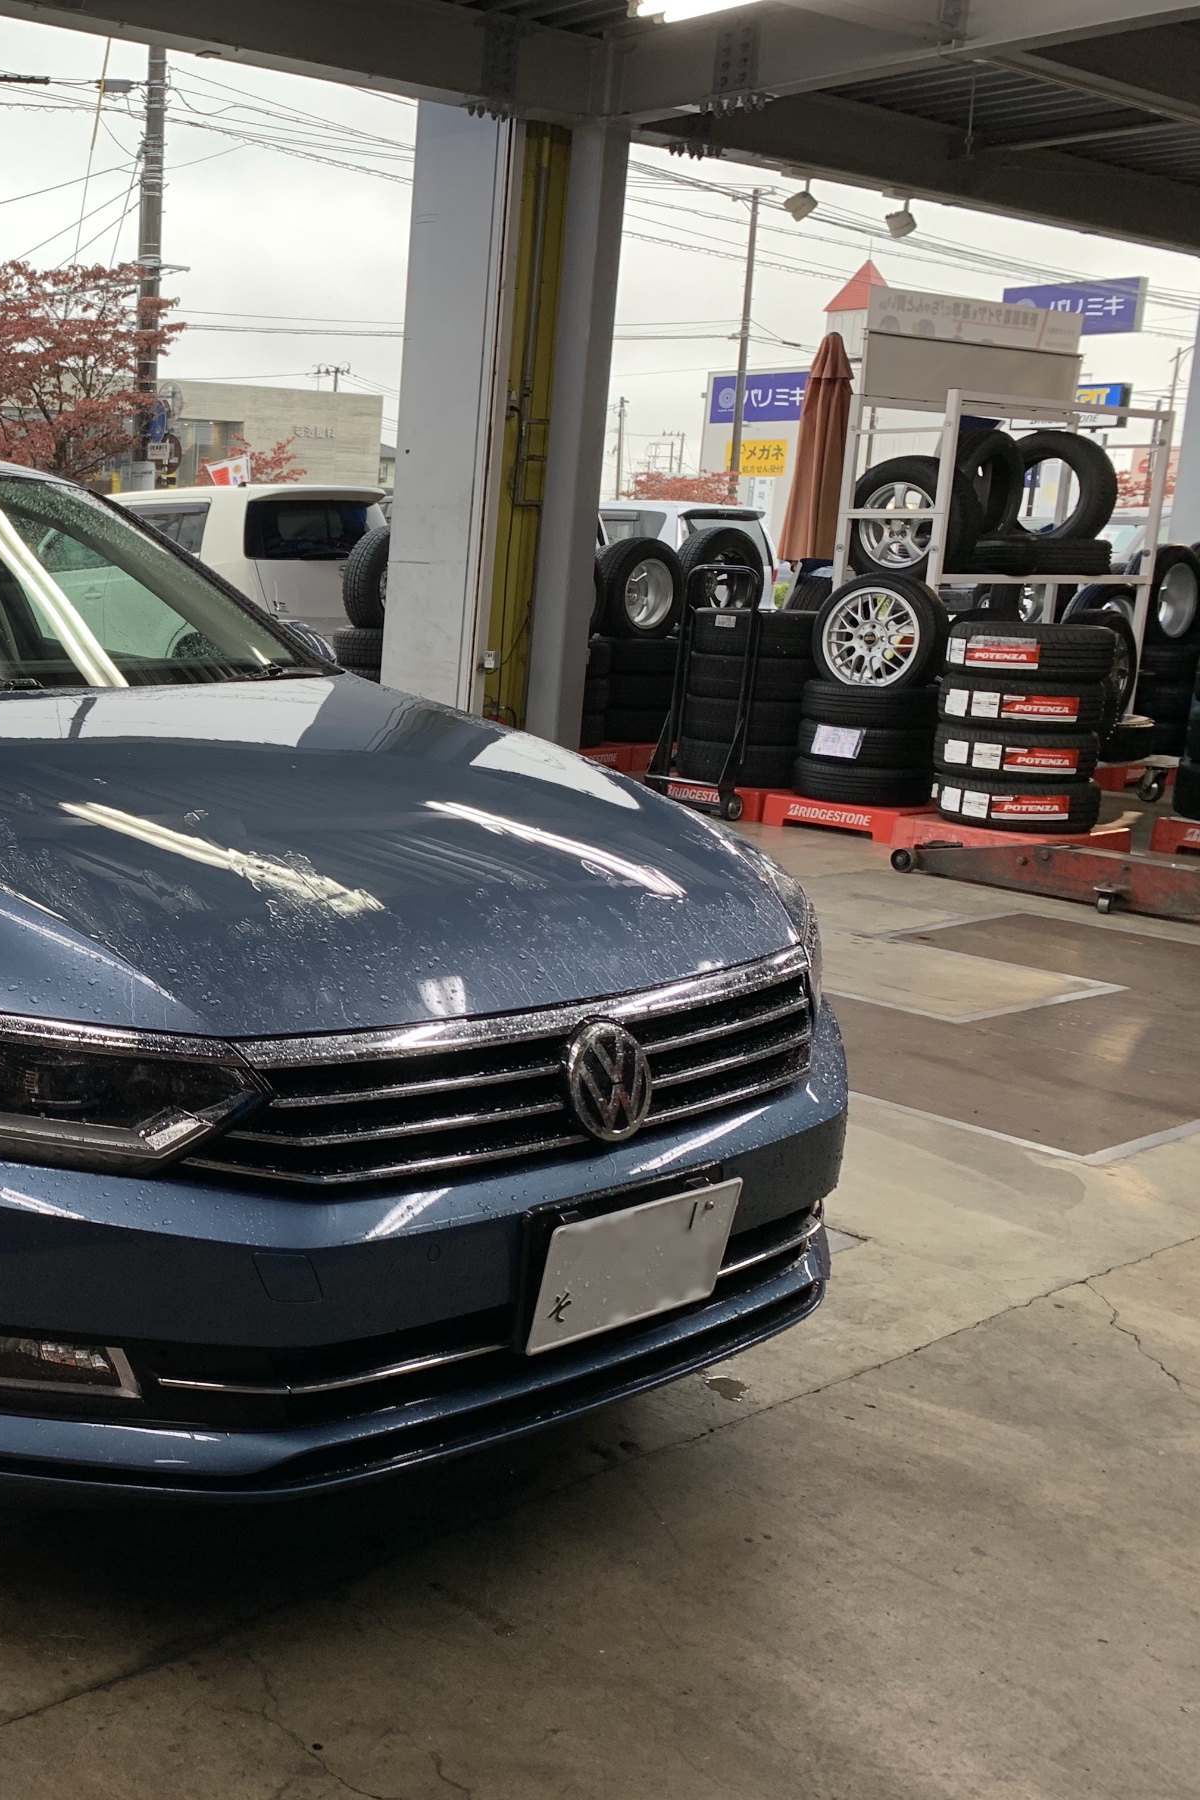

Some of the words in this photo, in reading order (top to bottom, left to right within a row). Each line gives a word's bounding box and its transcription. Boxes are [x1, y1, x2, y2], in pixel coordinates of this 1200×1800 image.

[1049, 295, 1125, 316] パリミキ
[743, 386, 805, 408] パリミキ
[745, 445, 784, 461] メガネ
[726, 464, 784, 474] 処方せん受付
[974, 652, 1028, 661] POTENZA
[1013, 704, 1070, 714] POTENZA
[1016, 756, 1070, 766] POTENZA
[667, 784, 721, 803] BRIDGESTO
[1003, 804, 1060, 812] POTENZA
[787, 803, 872, 827] BRIDGESTONE
